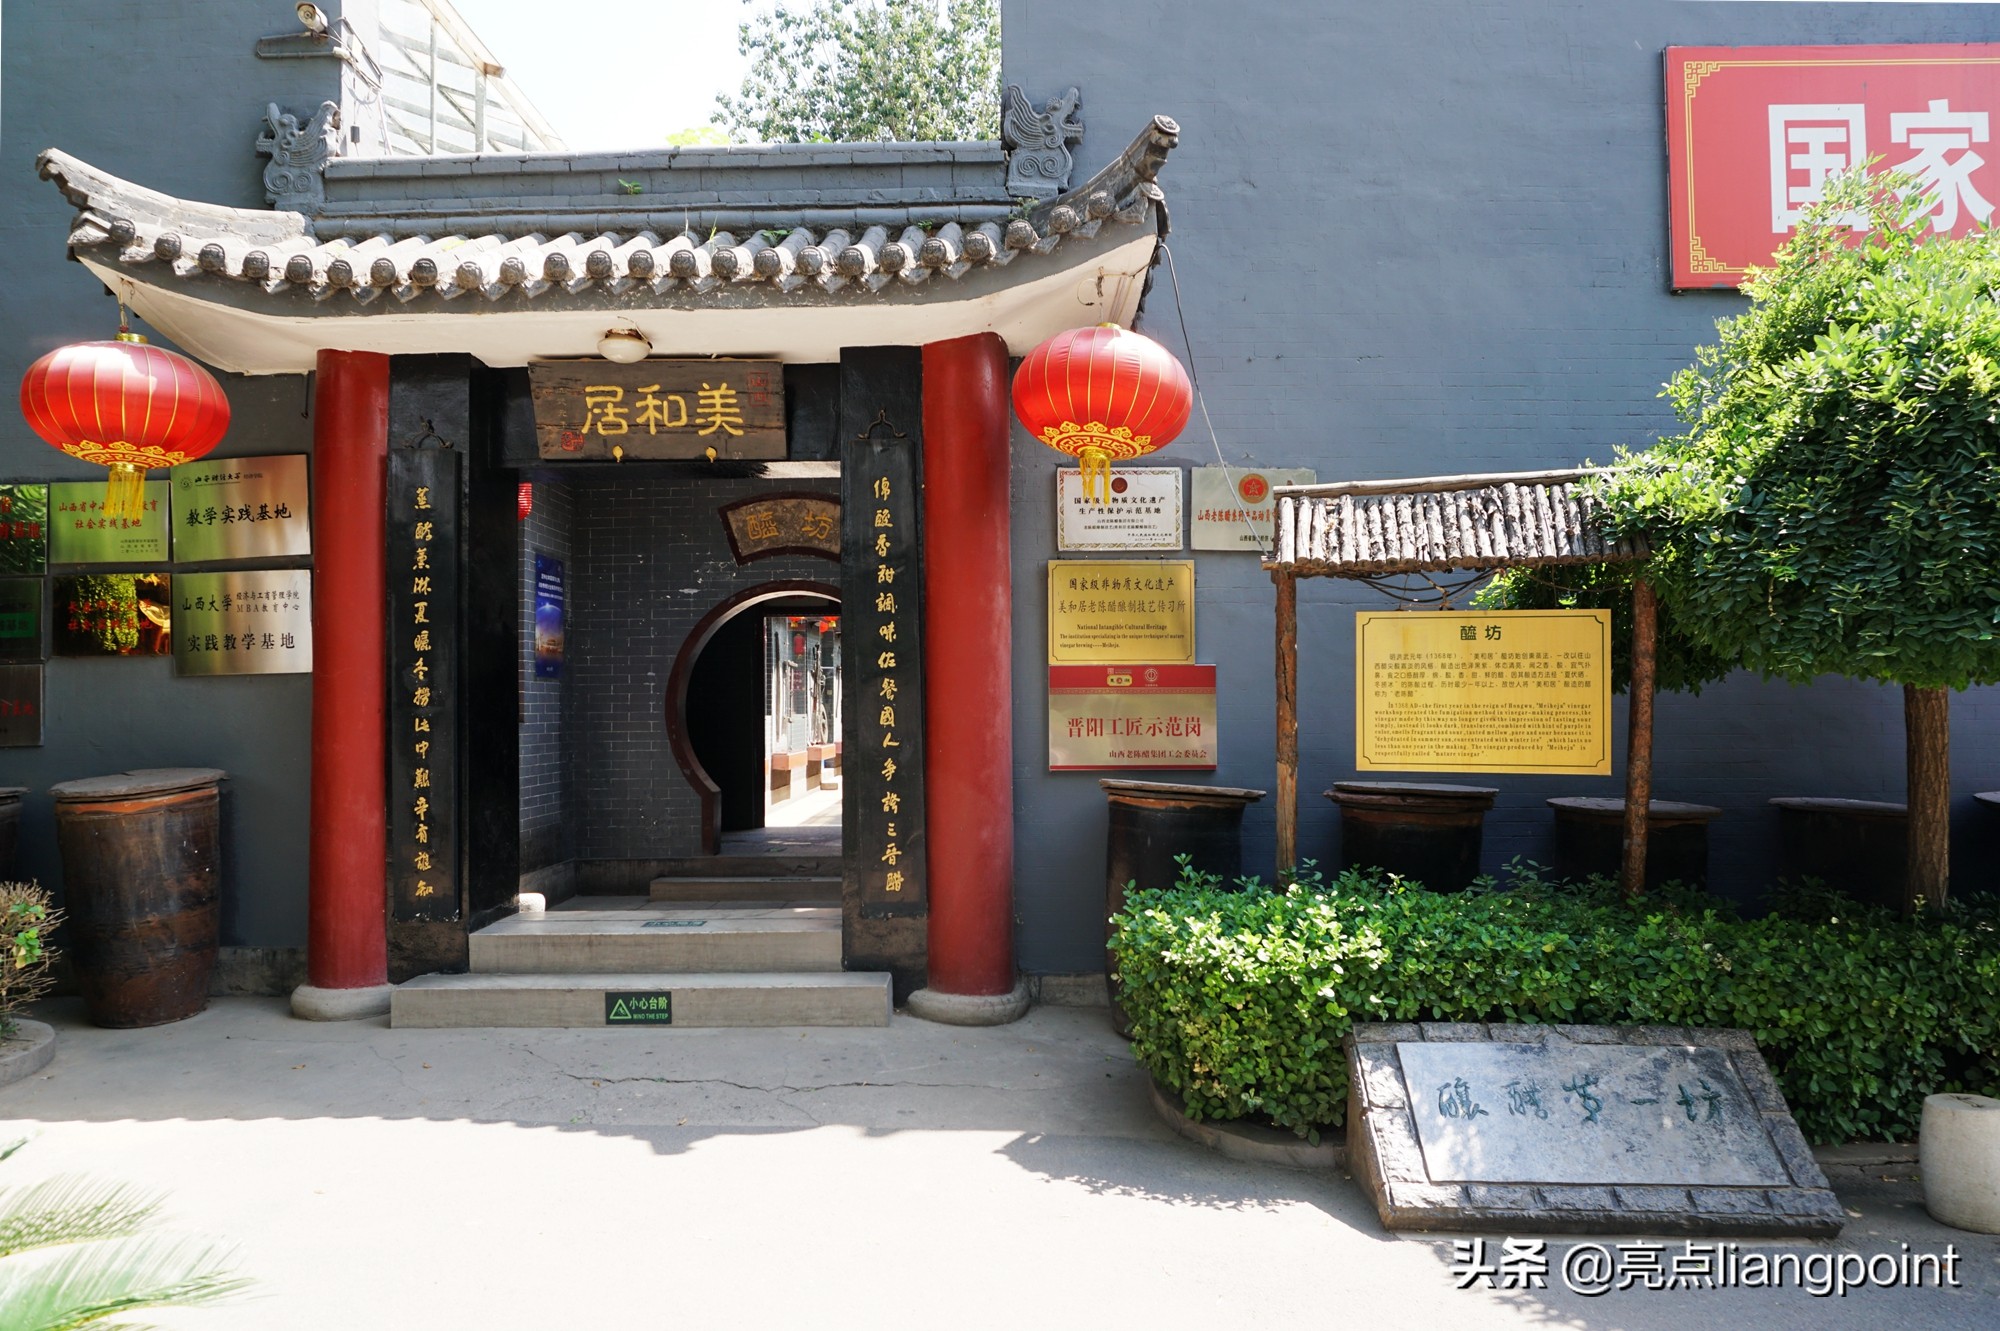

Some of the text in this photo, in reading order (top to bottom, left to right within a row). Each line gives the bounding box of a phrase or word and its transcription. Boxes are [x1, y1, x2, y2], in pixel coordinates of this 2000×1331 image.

[1768, 99, 1996, 233] 国家
[581, 382, 744, 436] 美和居
[1074, 496, 1166, 505] 国家级物质文化遗产
[186, 502, 292, 527] 教学实践基地
[1079, 507, 1162, 515] 生产性保护示范基地
[1069, 577, 1175, 591] 国家级非物质文化遗产
[182, 594, 233, 613] 山西大学
[1058, 600, 1186, 613] 美和居老陈醋酿制技艺传习所
[187, 632, 295, 652] 实践教学基地
[1066, 716, 1201, 738] 晋阳工匠示范岗
[1109, 749, 1207, 759] 山西老陈醋集团工会委员会
[629, 996, 668, 1010] 小心台阶
